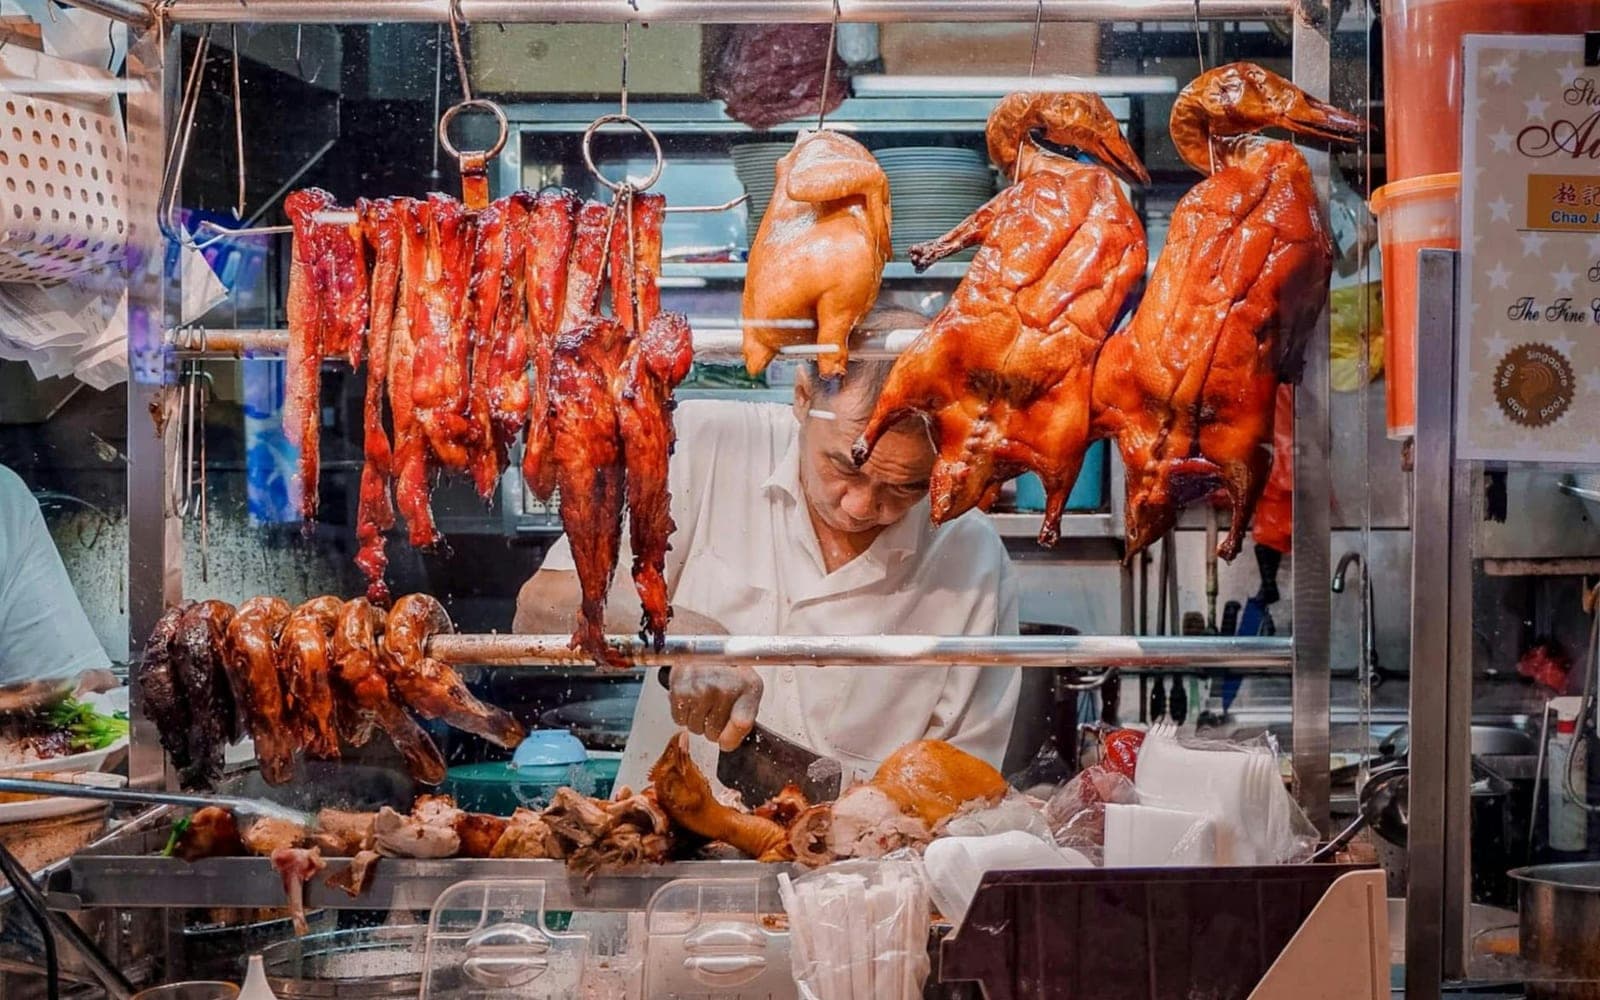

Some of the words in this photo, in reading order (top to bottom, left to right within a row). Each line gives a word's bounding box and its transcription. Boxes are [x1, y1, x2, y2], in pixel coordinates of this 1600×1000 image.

[1551, 211, 1587, 223] Chao
[1507, 297, 1540, 321] The
[1545, 298, 1585, 322] Fine
[1500, 363, 1515, 387] Web
[1526, 350, 1567, 386] Singapore
[1507, 397, 1528, 418] Map
[1540, 396, 1565, 417] Food
